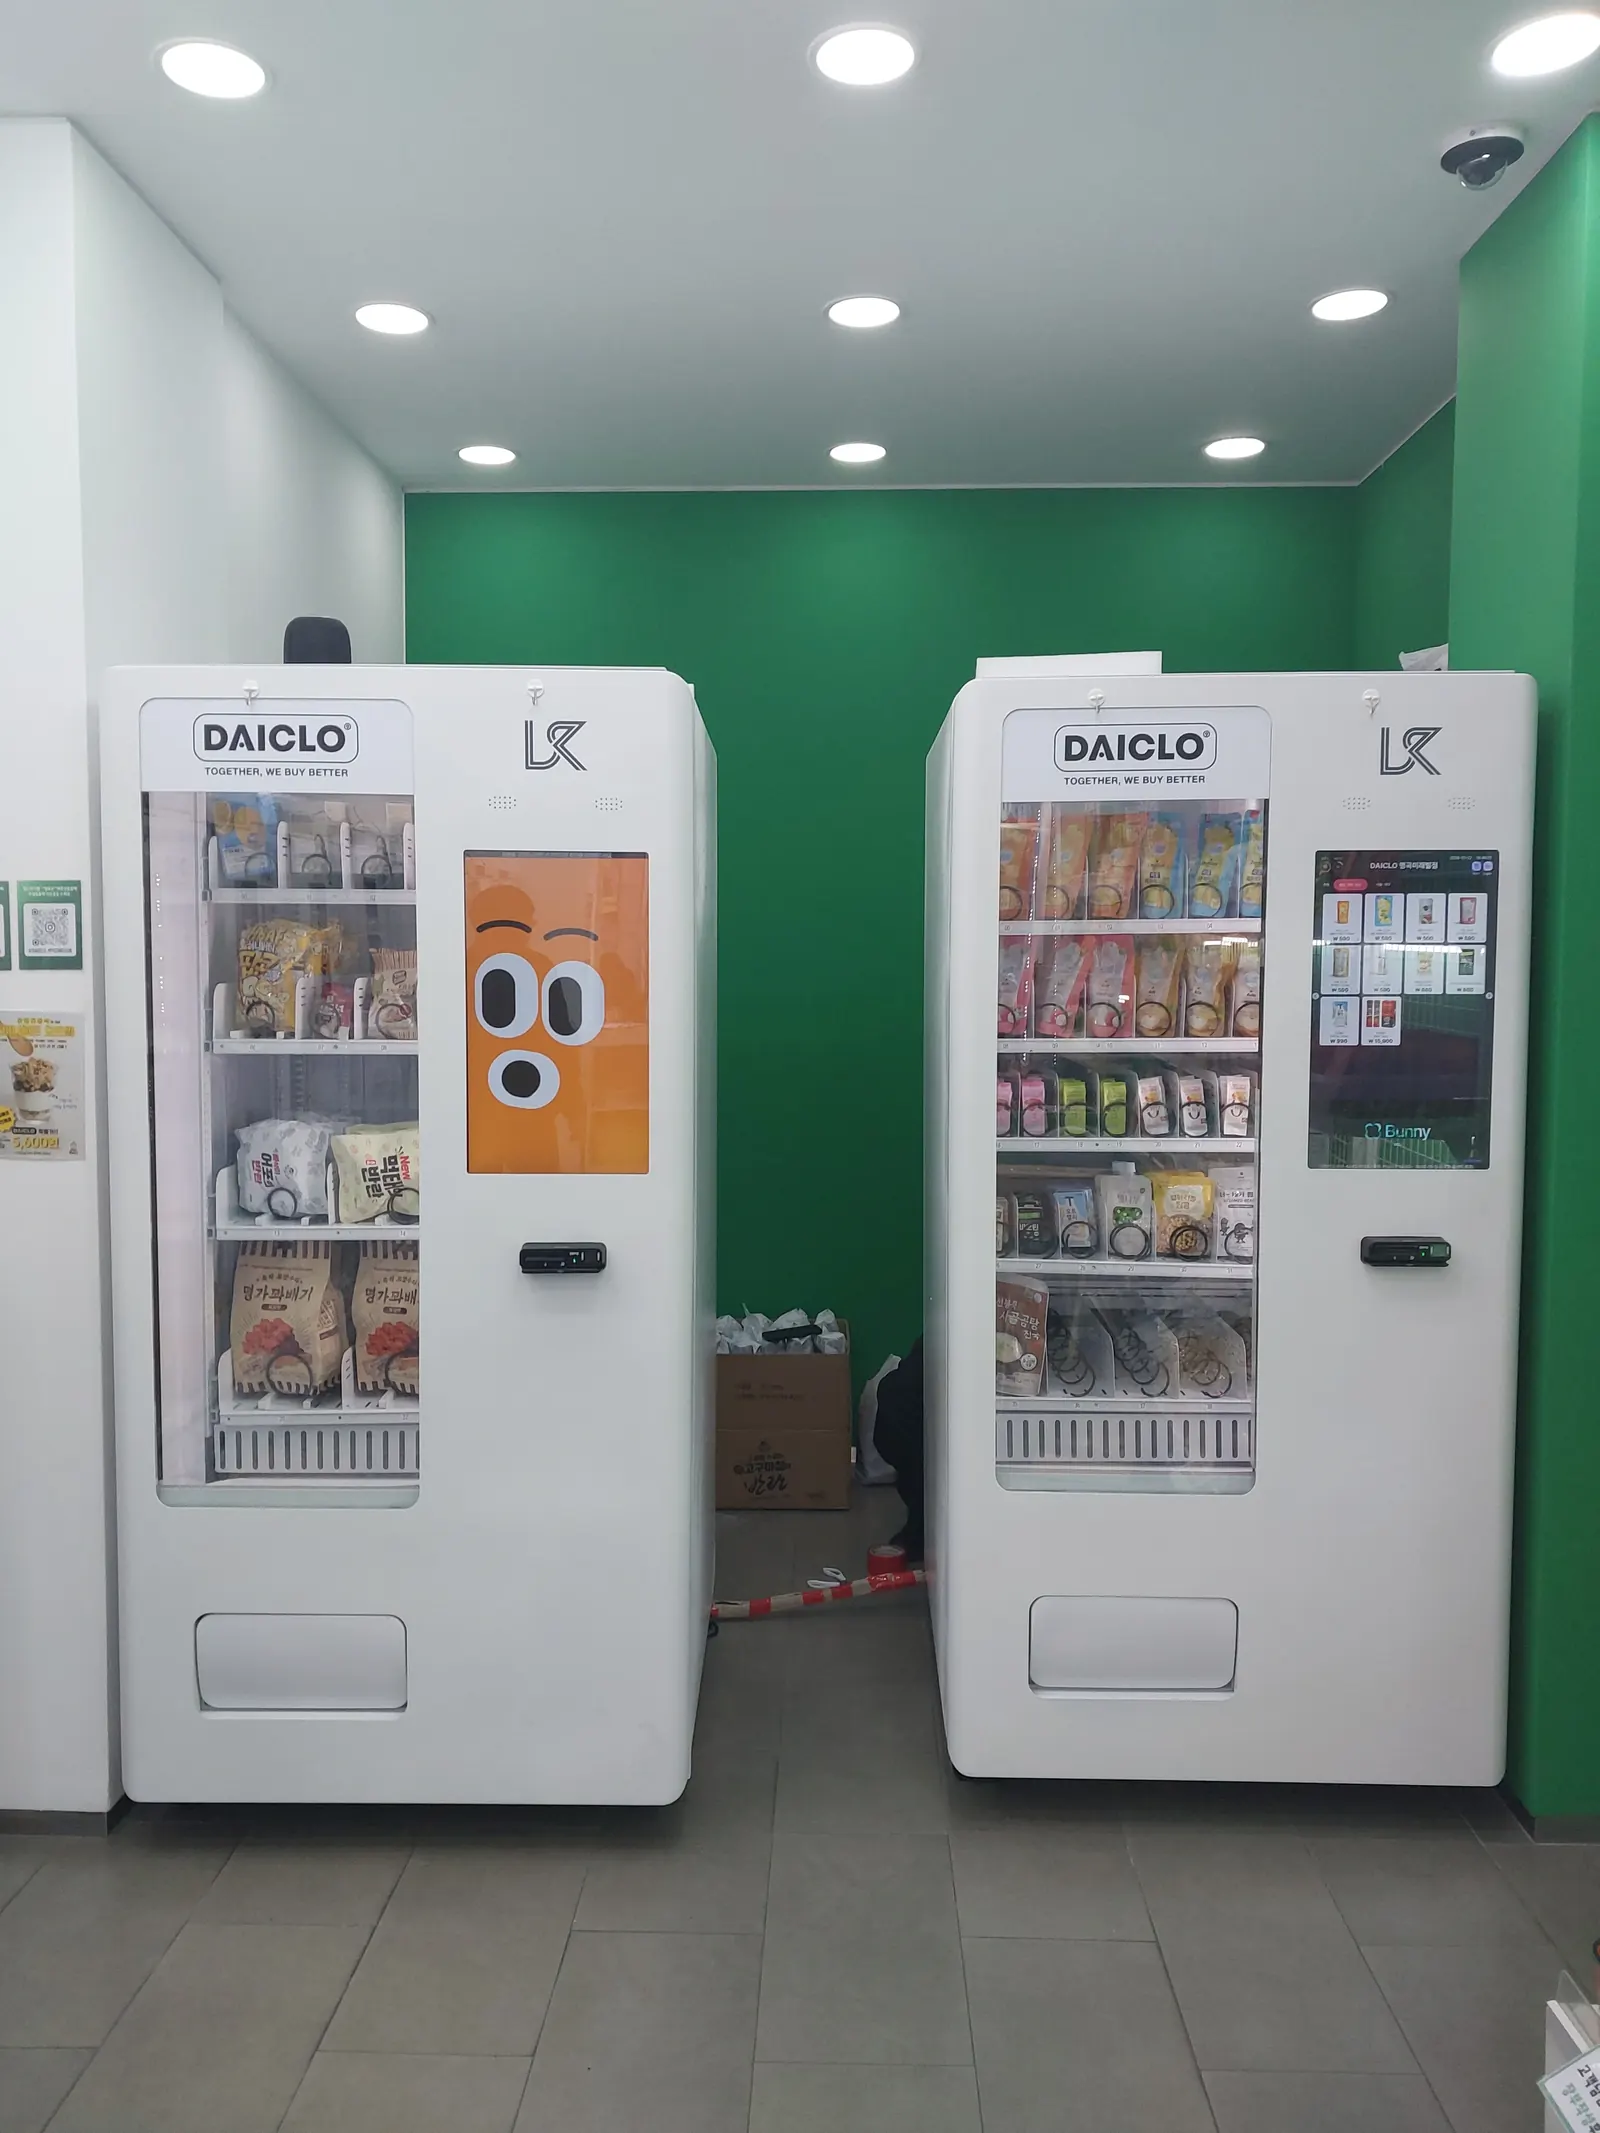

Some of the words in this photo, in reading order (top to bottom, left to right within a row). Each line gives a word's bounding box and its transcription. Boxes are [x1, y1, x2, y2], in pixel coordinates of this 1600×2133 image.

[204, 724, 346, 753] DAICLO
[1064, 732, 1205, 761] DAICLO
[205, 767, 263, 777] TOGETHER,
[266, 768, 281, 776] WE
[284, 768, 306, 777] BUY
[309, 768, 349, 777] BETTER
[1064, 776, 1121, 786] TOGETHER,
[1124, 776, 1140, 785] WE
[1143, 776, 1164, 784] BUY
[1166, 775, 1206, 784] BETTER
[1369, 861, 1398, 869] DAICLO
[1385, 1124, 1431, 1141] Bunny
[399, 1155, 411, 1180] New
[361, 1165, 385, 1199] 반란
[365, 1287, 419, 1307] 명가꽈배
